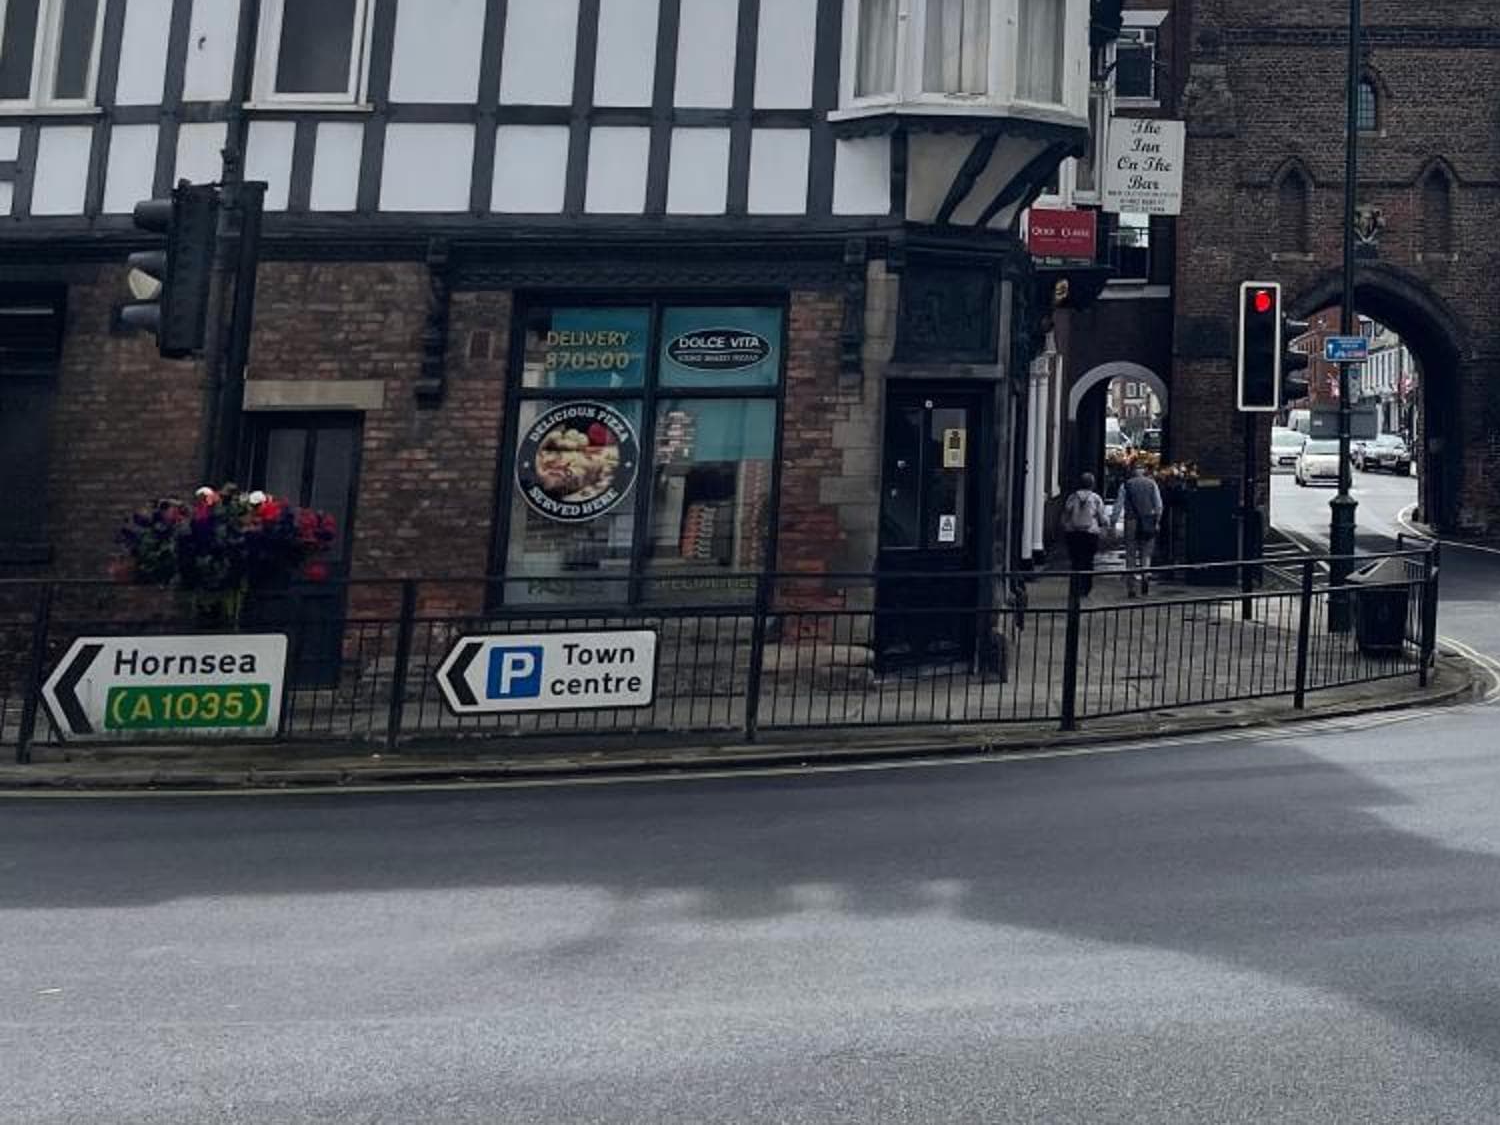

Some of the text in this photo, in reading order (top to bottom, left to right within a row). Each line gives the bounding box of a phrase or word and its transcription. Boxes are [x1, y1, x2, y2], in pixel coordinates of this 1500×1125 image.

[1142, 156, 1173, 172] The
[547, 331, 630, 347] DELIVERY
[679, 336, 760, 348] DOLCE VITA
[529, 407, 630, 443] DELICIOUS PIZZA
[528, 486, 619, 515] SERVED HERE
[114, 648, 257, 675] Hornsea
[562, 643, 635, 666] Town
[500, 652, 535, 694] P
[551, 673, 642, 696] centre
